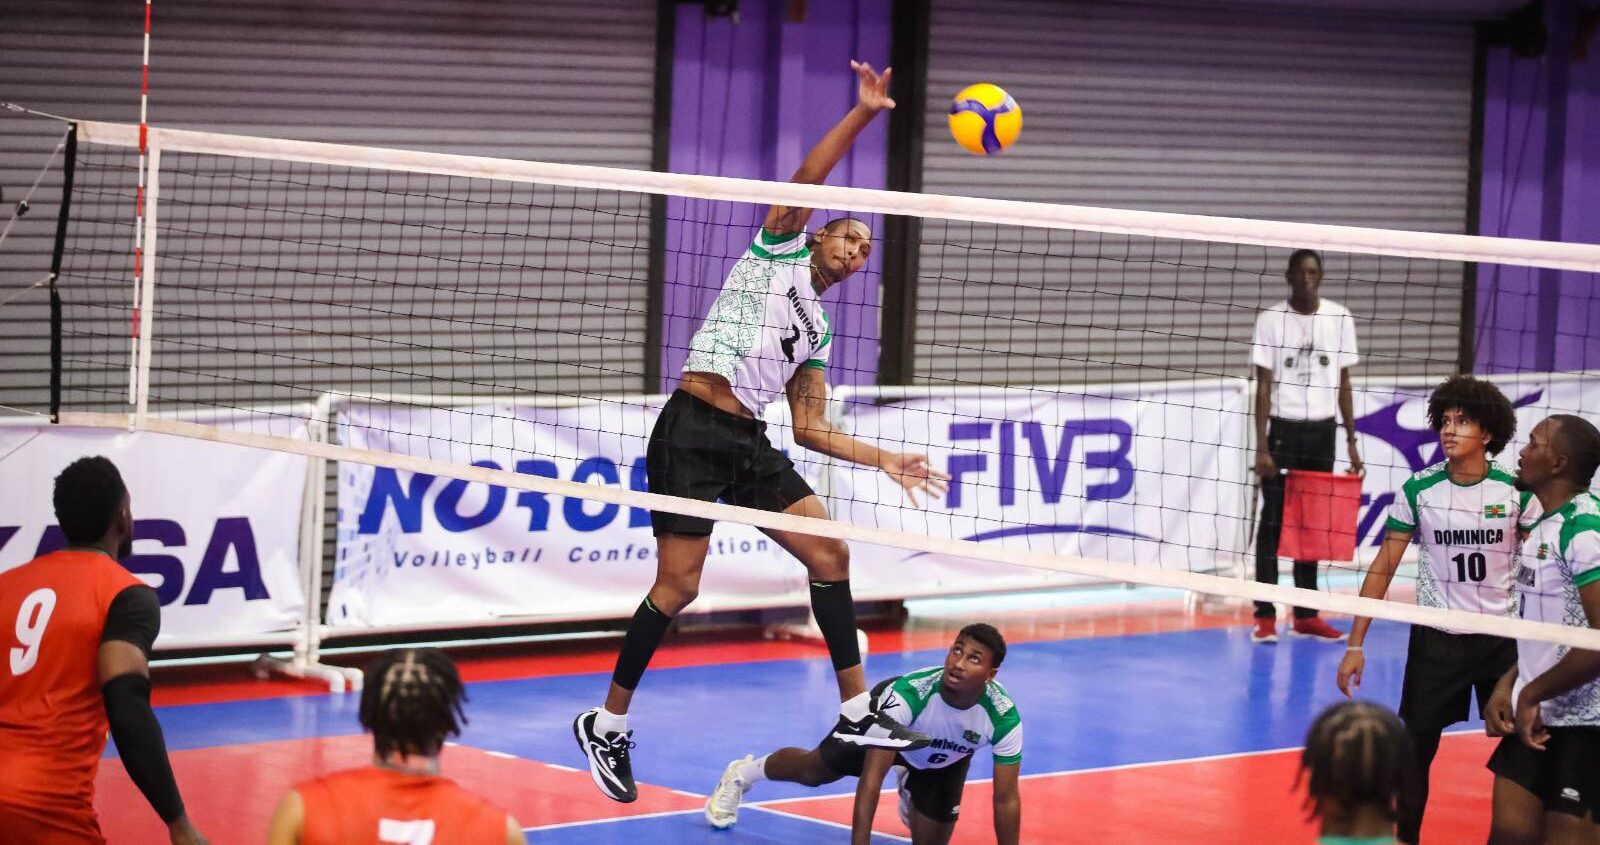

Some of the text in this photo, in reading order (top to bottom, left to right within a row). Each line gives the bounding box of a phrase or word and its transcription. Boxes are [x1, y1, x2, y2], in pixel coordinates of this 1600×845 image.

[946, 418, 1136, 508] FIVB
[393, 537, 768, 569] Volleyball Confetion
[1433, 528, 1504, 546] DOMINICA
[1451, 552, 1487, 583] 10
[9, 587, 57, 676] 9
